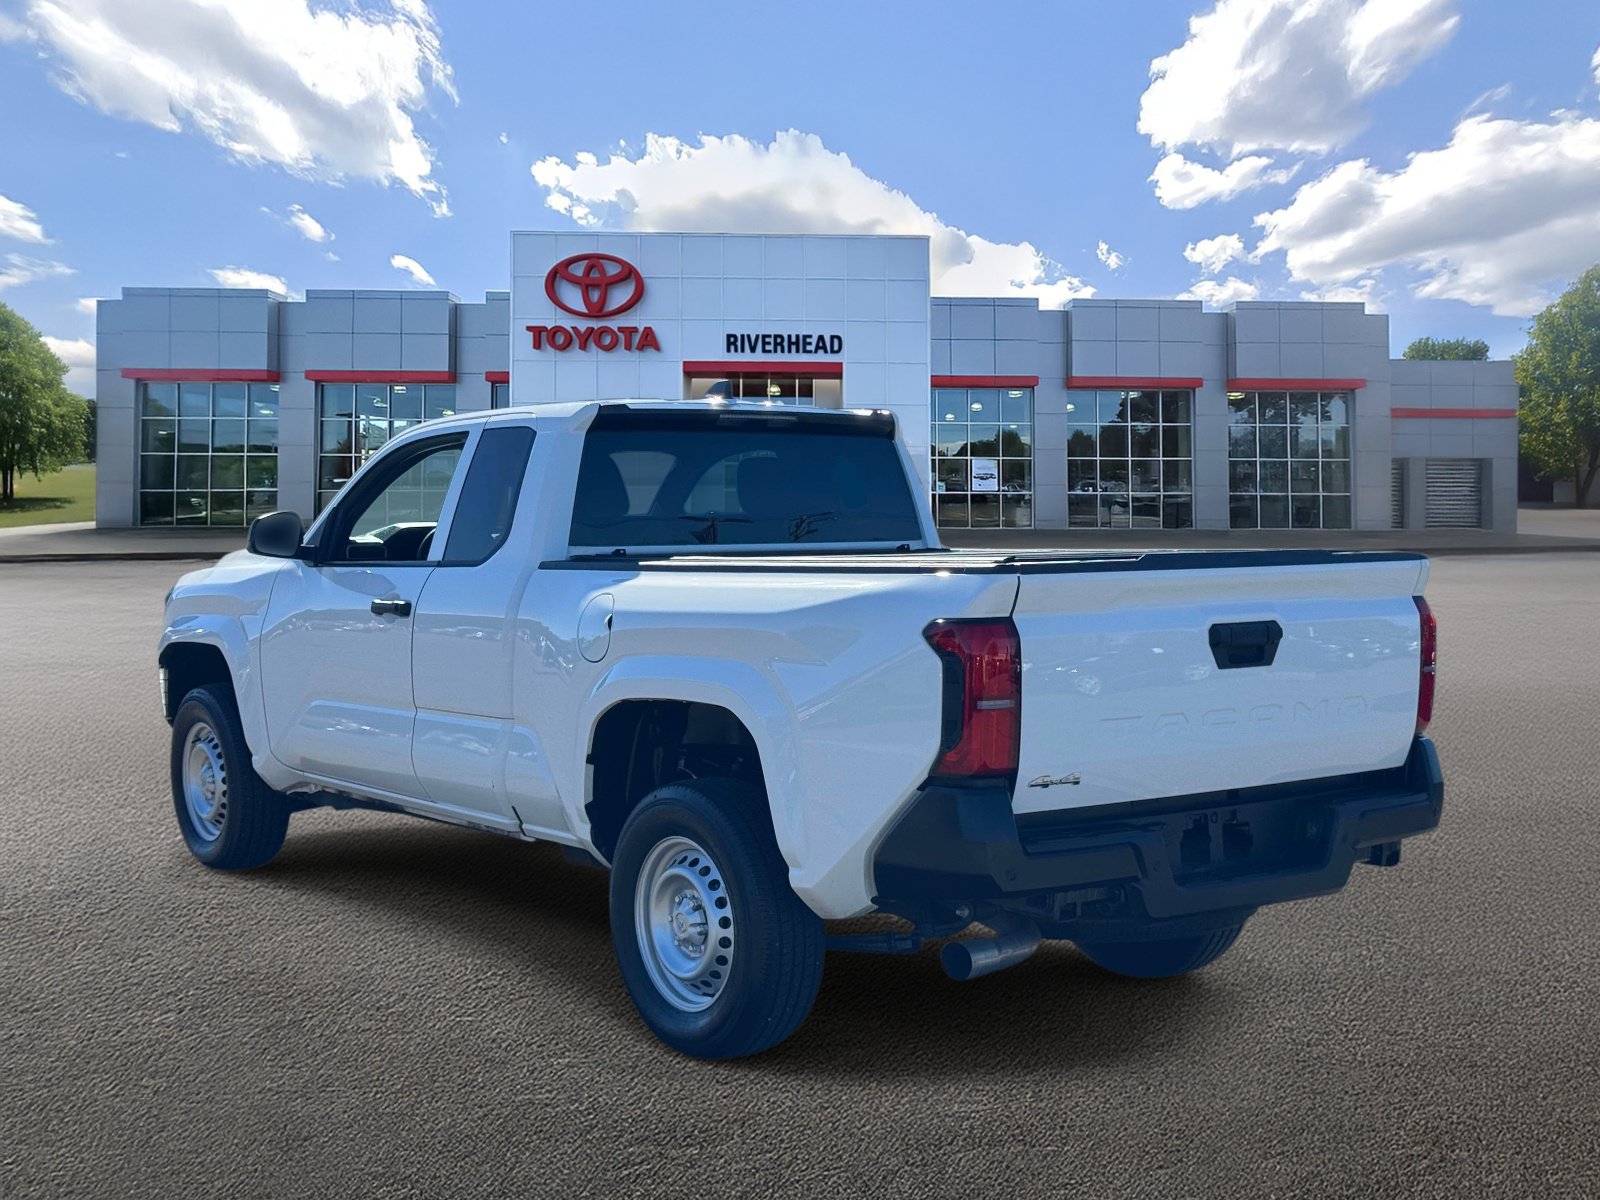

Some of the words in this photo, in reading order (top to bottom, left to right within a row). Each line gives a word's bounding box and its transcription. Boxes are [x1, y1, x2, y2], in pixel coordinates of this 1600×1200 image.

[526, 325, 661, 351] TOYOTA
[726, 333, 843, 354] RIVERHEAD
[1099, 694, 1368, 736] TACOMA
